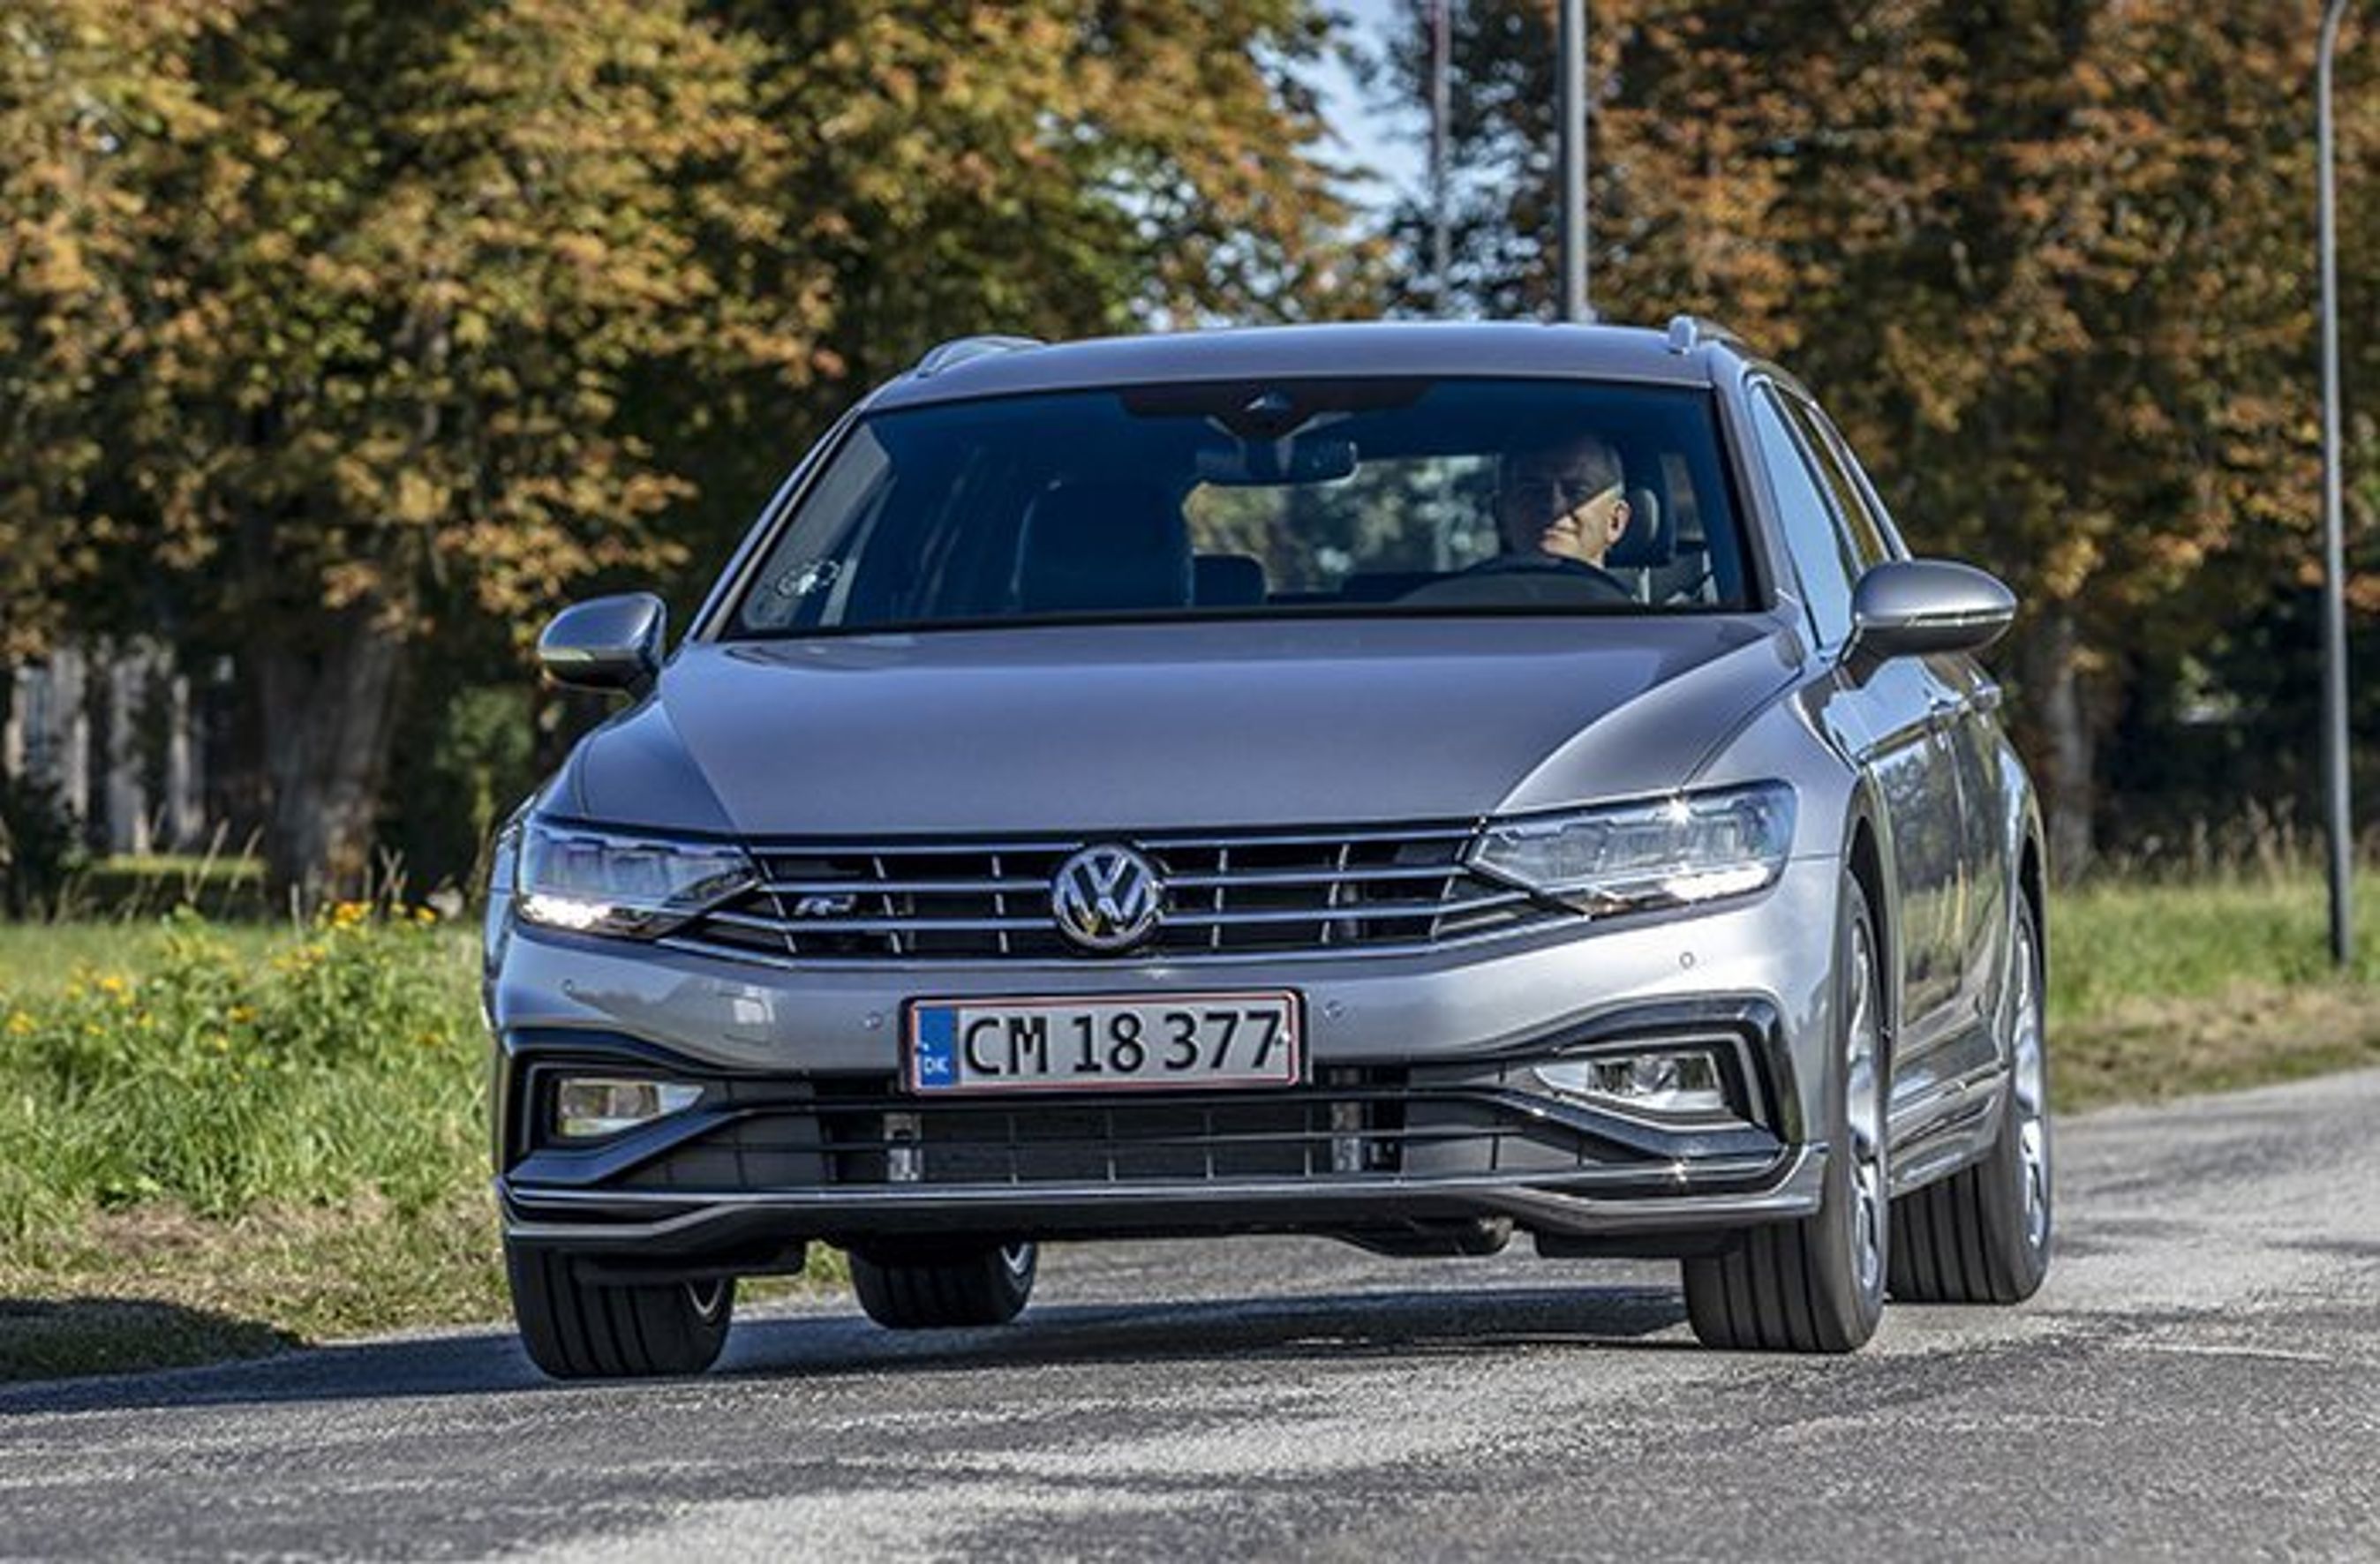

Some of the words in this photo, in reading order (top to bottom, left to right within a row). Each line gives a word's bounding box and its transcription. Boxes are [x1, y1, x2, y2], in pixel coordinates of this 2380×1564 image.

[964, 1015, 1048, 1075] CM
[1073, 1012, 1143, 1073] 18
[1164, 1010, 1282, 1071] 377
[923, 1056, 949, 1075] DK
